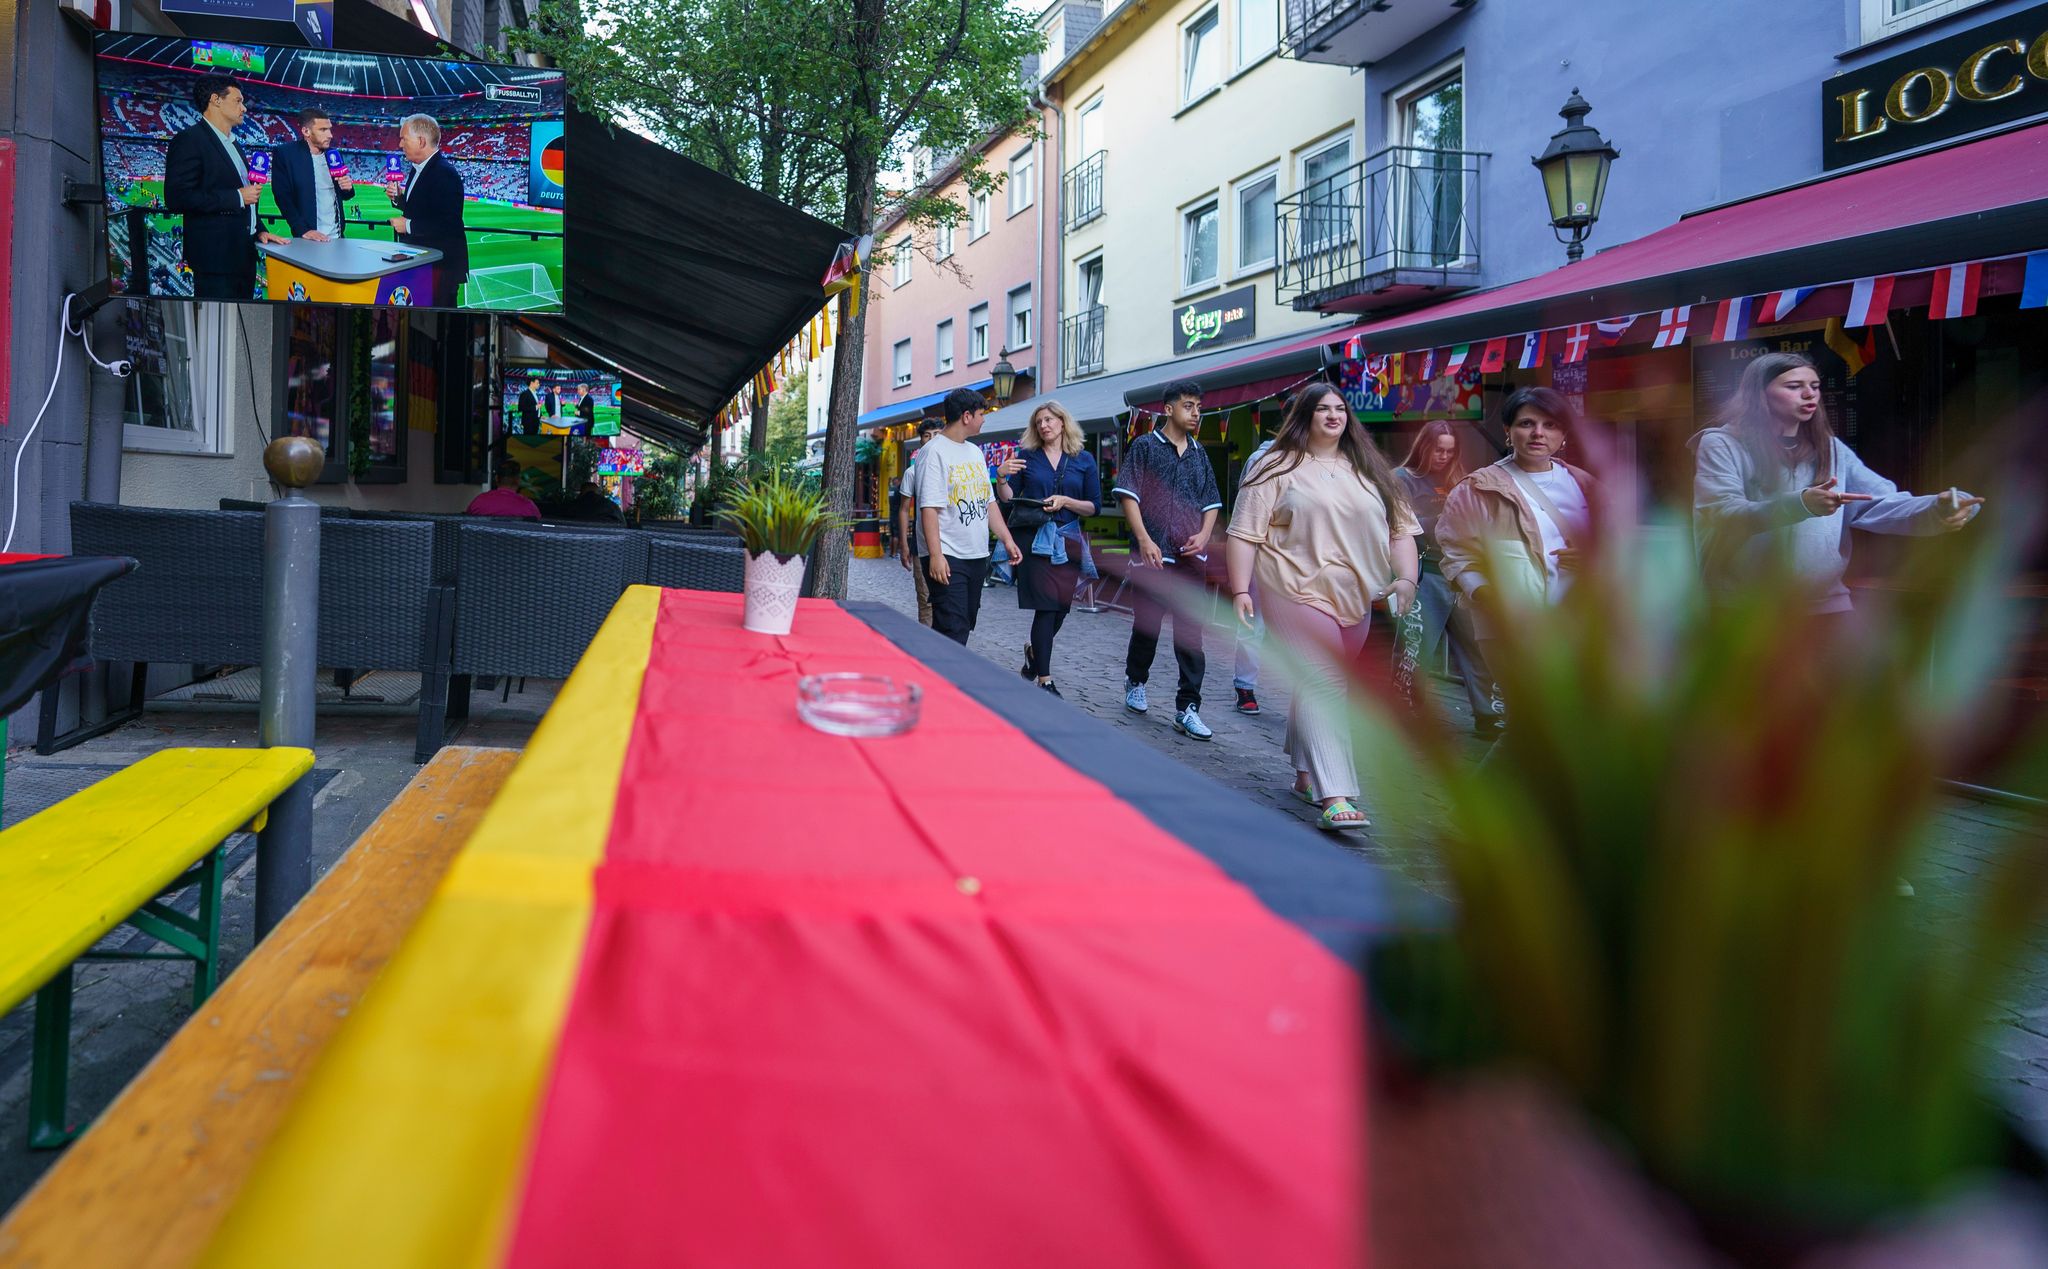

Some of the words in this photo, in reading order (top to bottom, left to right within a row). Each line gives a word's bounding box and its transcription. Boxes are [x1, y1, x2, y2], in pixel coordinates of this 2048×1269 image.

[498, 89, 534, 99] FUSSBALL.TV
[1180, 304, 1222, 349] Crazy
[1730, 346, 1769, 360] Loco
[1779, 340, 1812, 352] Bar
[1345, 390, 1384, 410] 2024
